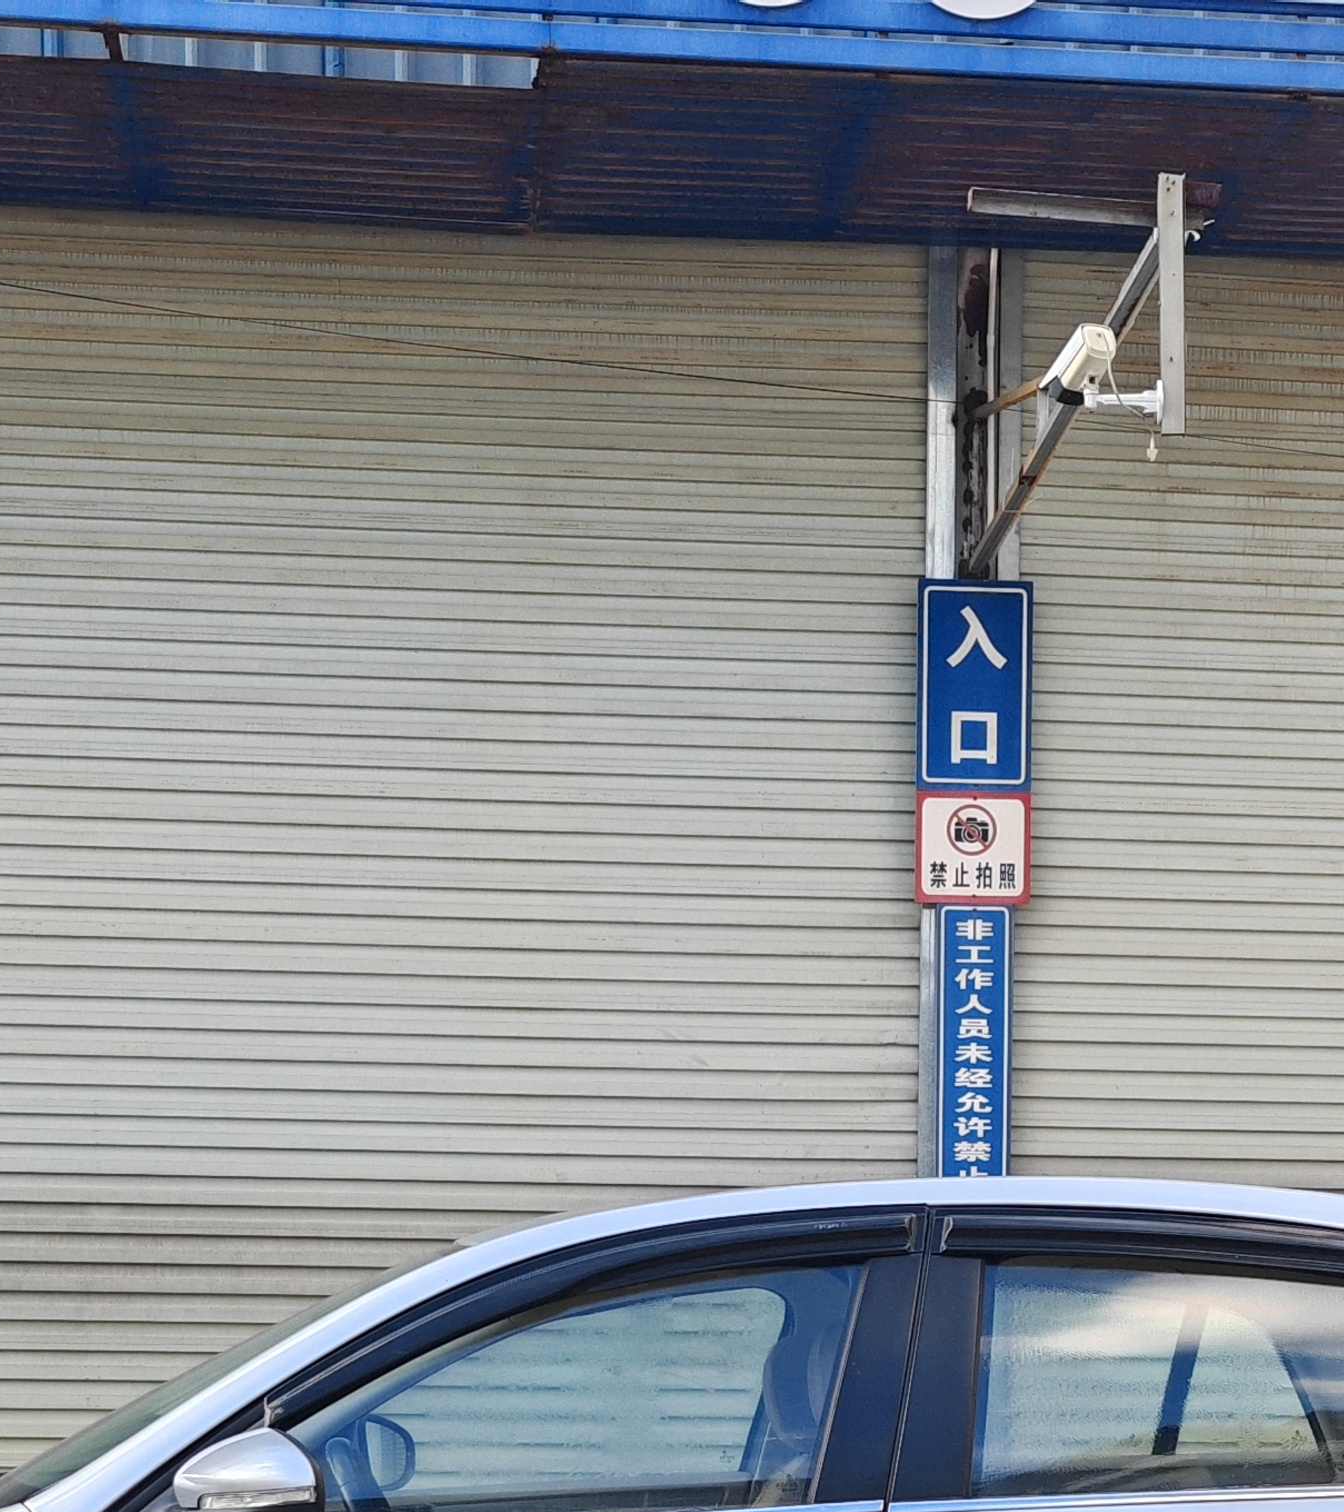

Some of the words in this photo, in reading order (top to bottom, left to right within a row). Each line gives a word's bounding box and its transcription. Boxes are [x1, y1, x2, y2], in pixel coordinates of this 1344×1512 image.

[946, 605, 1008, 765] 入口
[929, 861, 1017, 890] 禁止拍照
